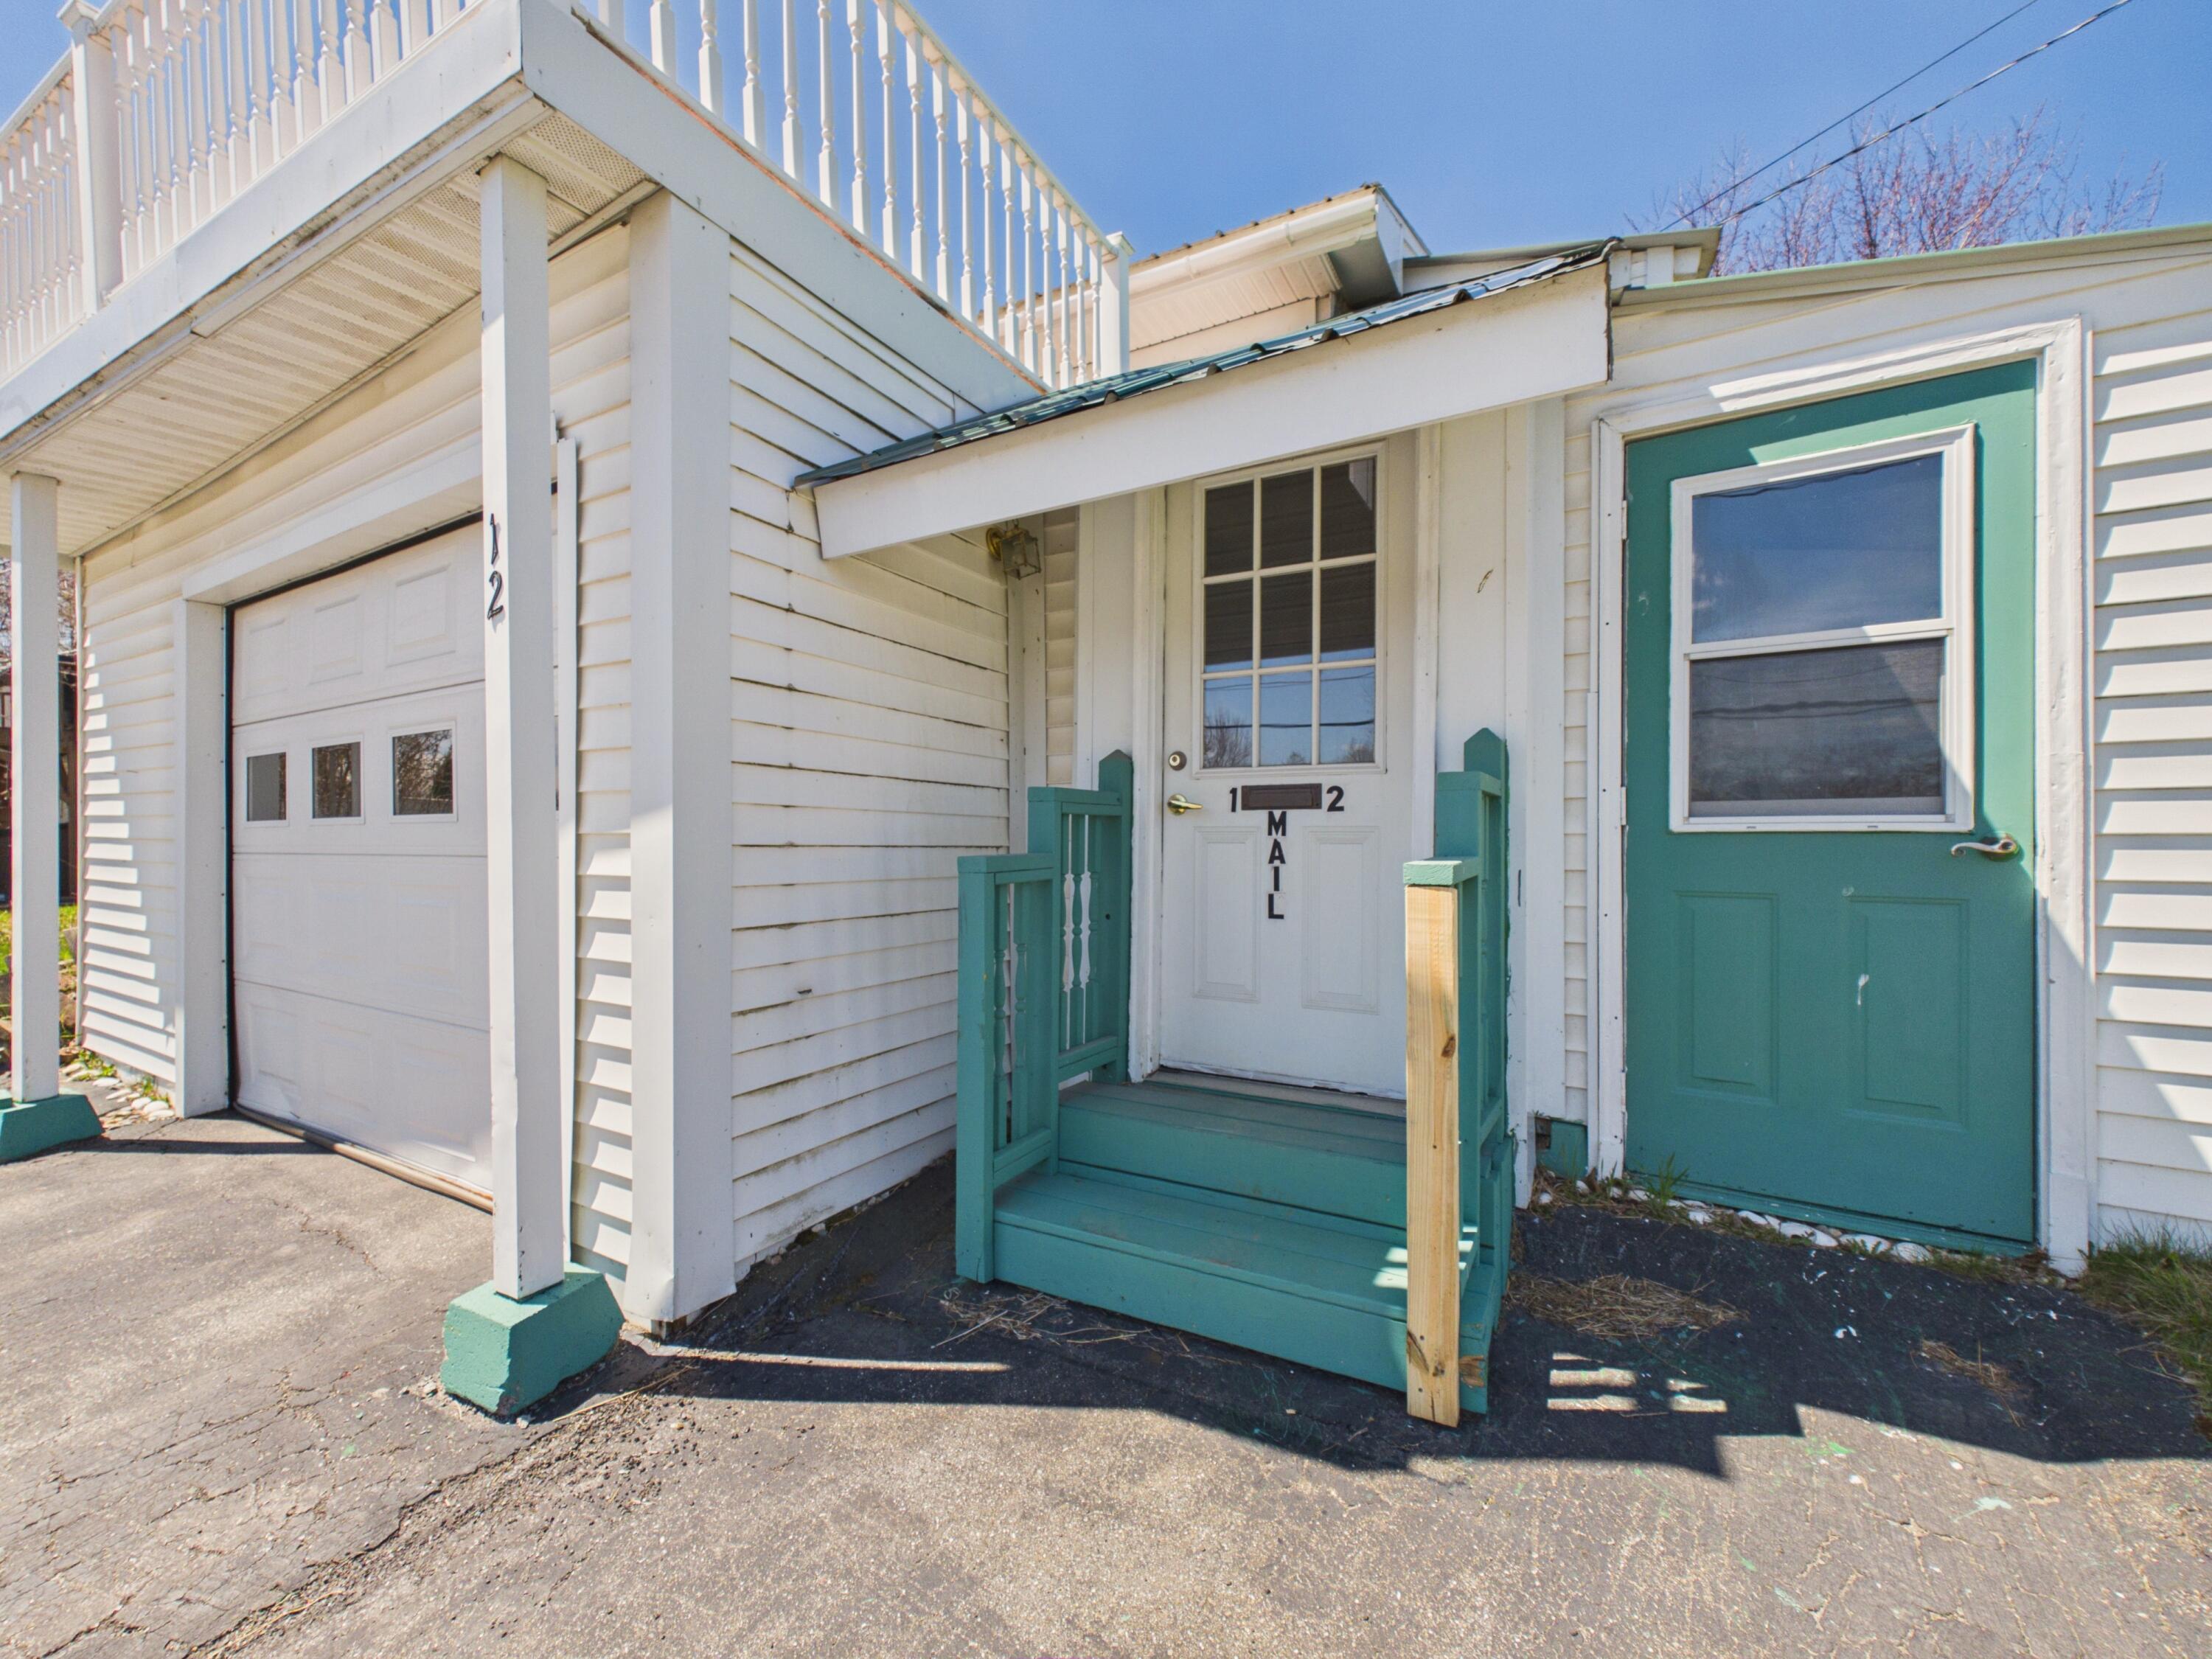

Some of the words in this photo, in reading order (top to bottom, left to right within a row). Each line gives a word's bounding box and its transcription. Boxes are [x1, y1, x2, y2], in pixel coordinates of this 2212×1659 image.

[487, 512, 505, 620] 12
[1229, 787, 1237, 813] 1
[1326, 785, 1344, 811] 2
[1267, 811, 1287, 919] MAIL
